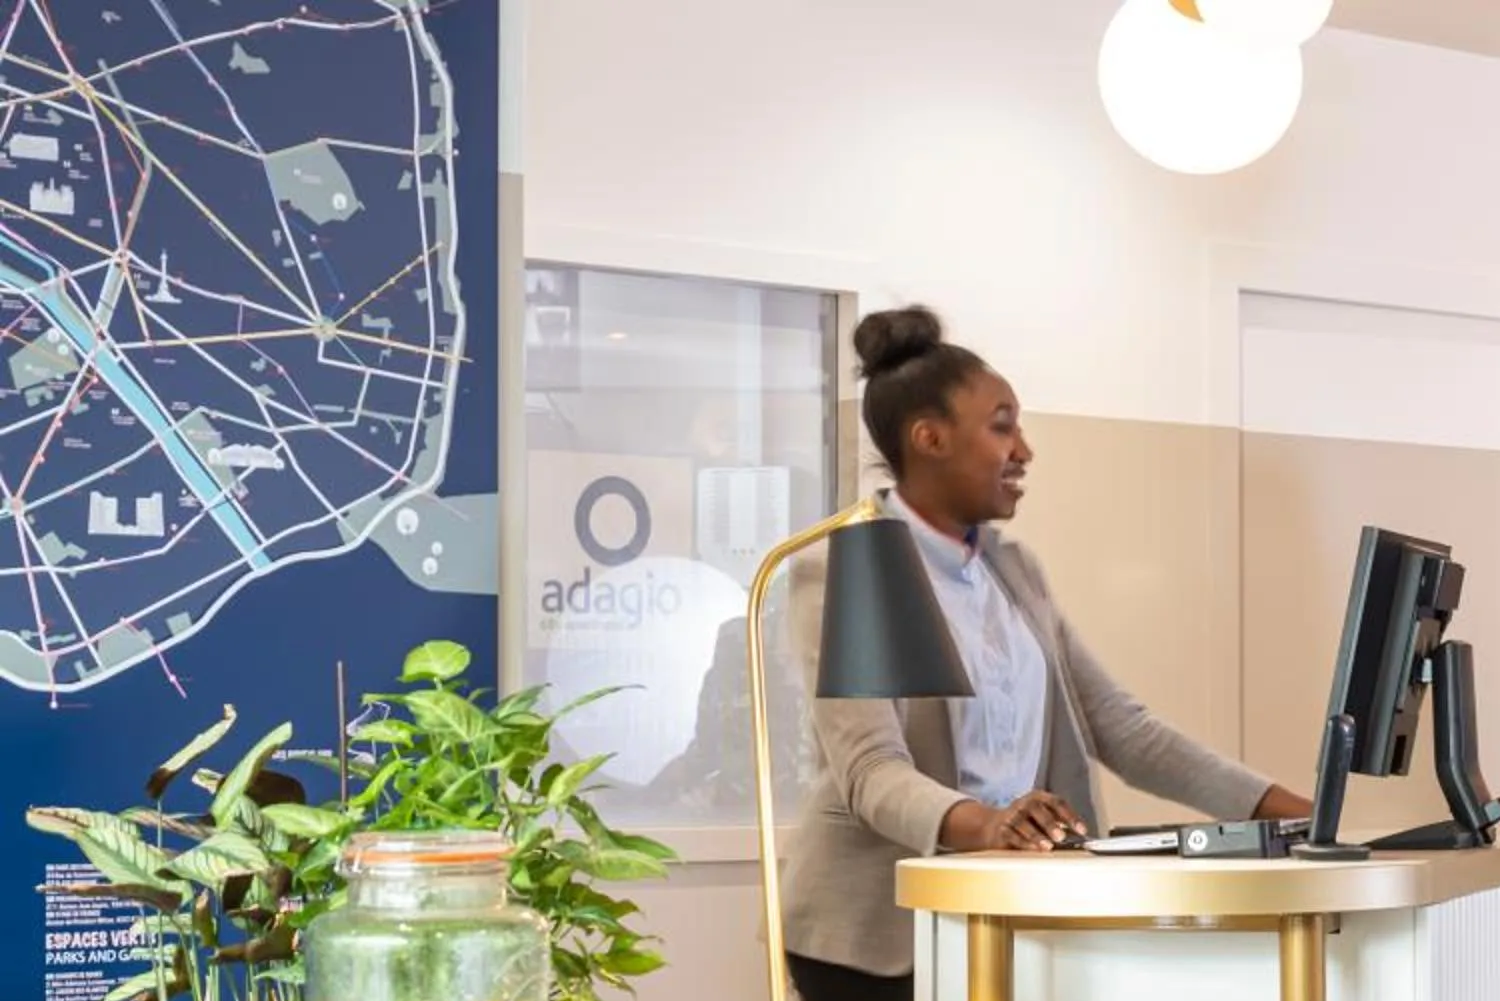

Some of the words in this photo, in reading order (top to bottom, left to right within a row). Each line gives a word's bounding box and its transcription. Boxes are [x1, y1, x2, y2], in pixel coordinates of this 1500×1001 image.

[541, 566, 682, 630] adagio
[45, 930, 107, 949] ESPACES
[45, 951, 85, 965] PARKS
[88, 950, 116, 963] AND
